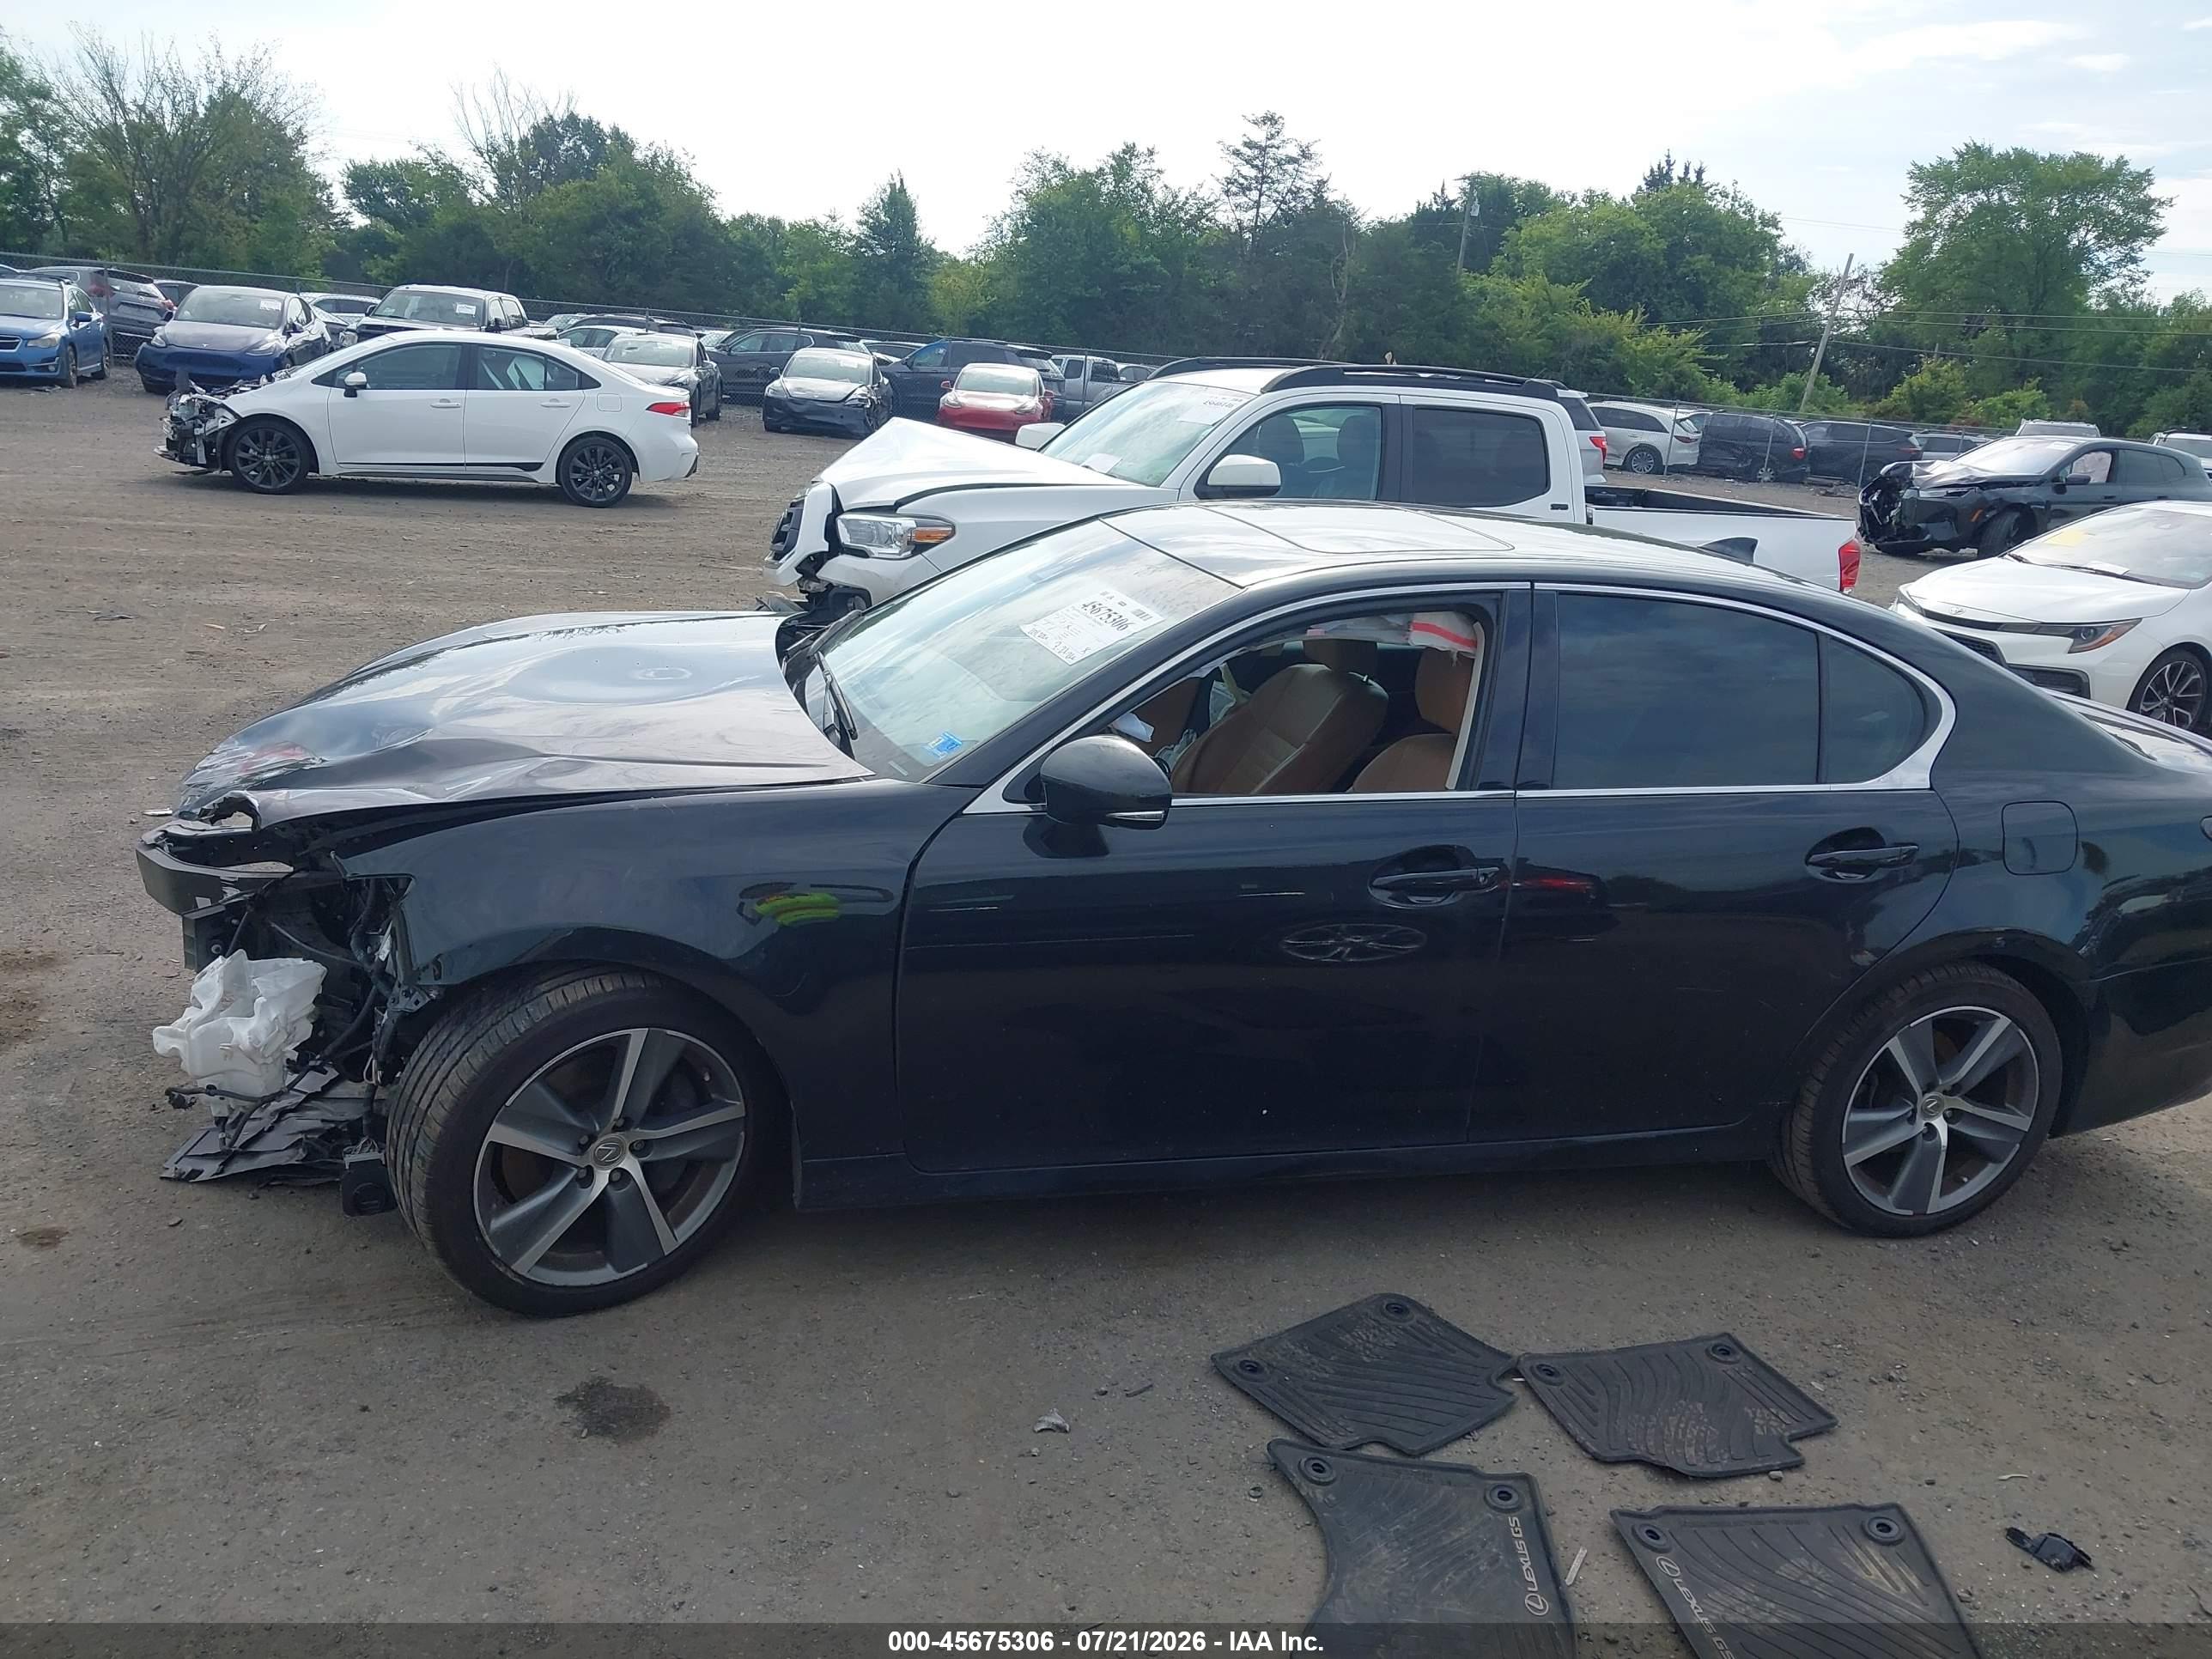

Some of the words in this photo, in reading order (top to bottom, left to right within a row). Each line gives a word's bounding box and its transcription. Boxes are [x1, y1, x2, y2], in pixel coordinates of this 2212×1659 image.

[1081, 600, 1135, 631] 45675306
[1508, 1516, 1524, 1539] GS
[1516, 1540, 1539, 1592] LEXUS
[1673, 1578, 1717, 1634] LEXUS
